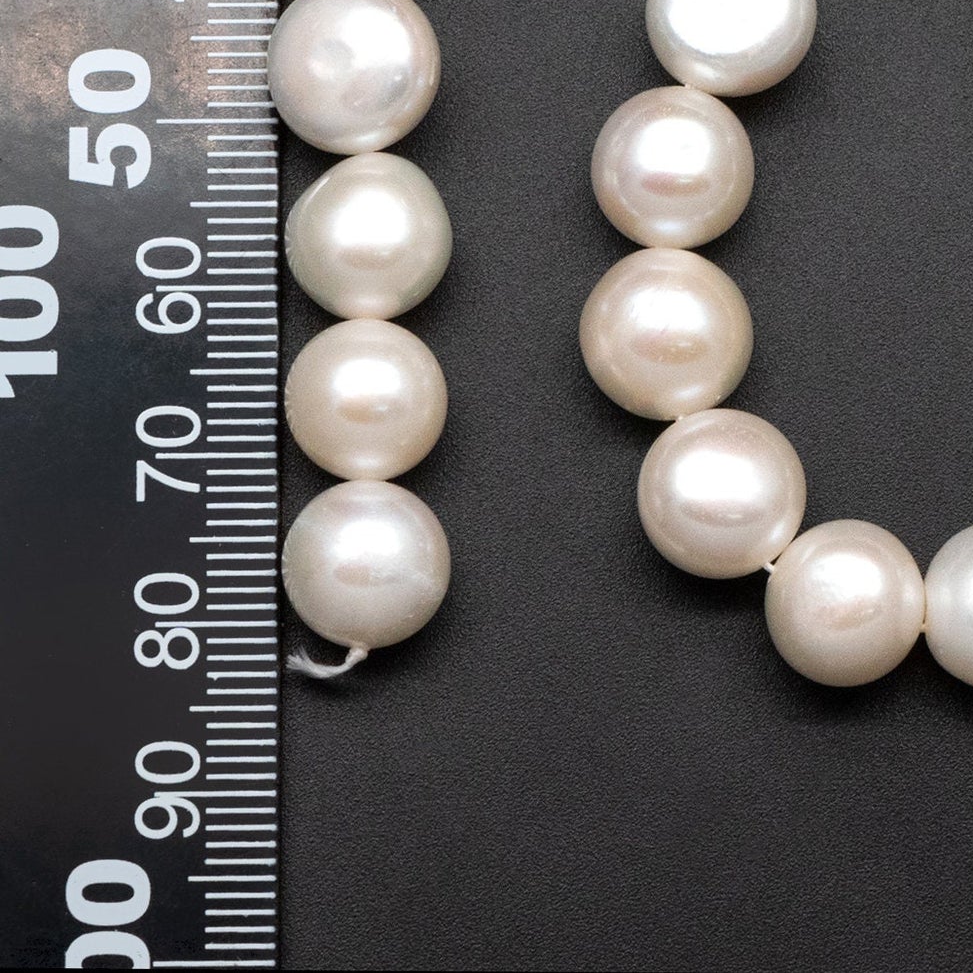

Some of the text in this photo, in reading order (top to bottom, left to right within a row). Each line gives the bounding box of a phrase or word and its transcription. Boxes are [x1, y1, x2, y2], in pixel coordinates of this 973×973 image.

[67, 48, 152, 190] 50
[0, 204, 60, 399] 100
[135, 237, 201, 335] 60
[134, 405, 201, 502] 70
[133, 572, 200, 670] 80
[133, 740, 200, 840] 90
